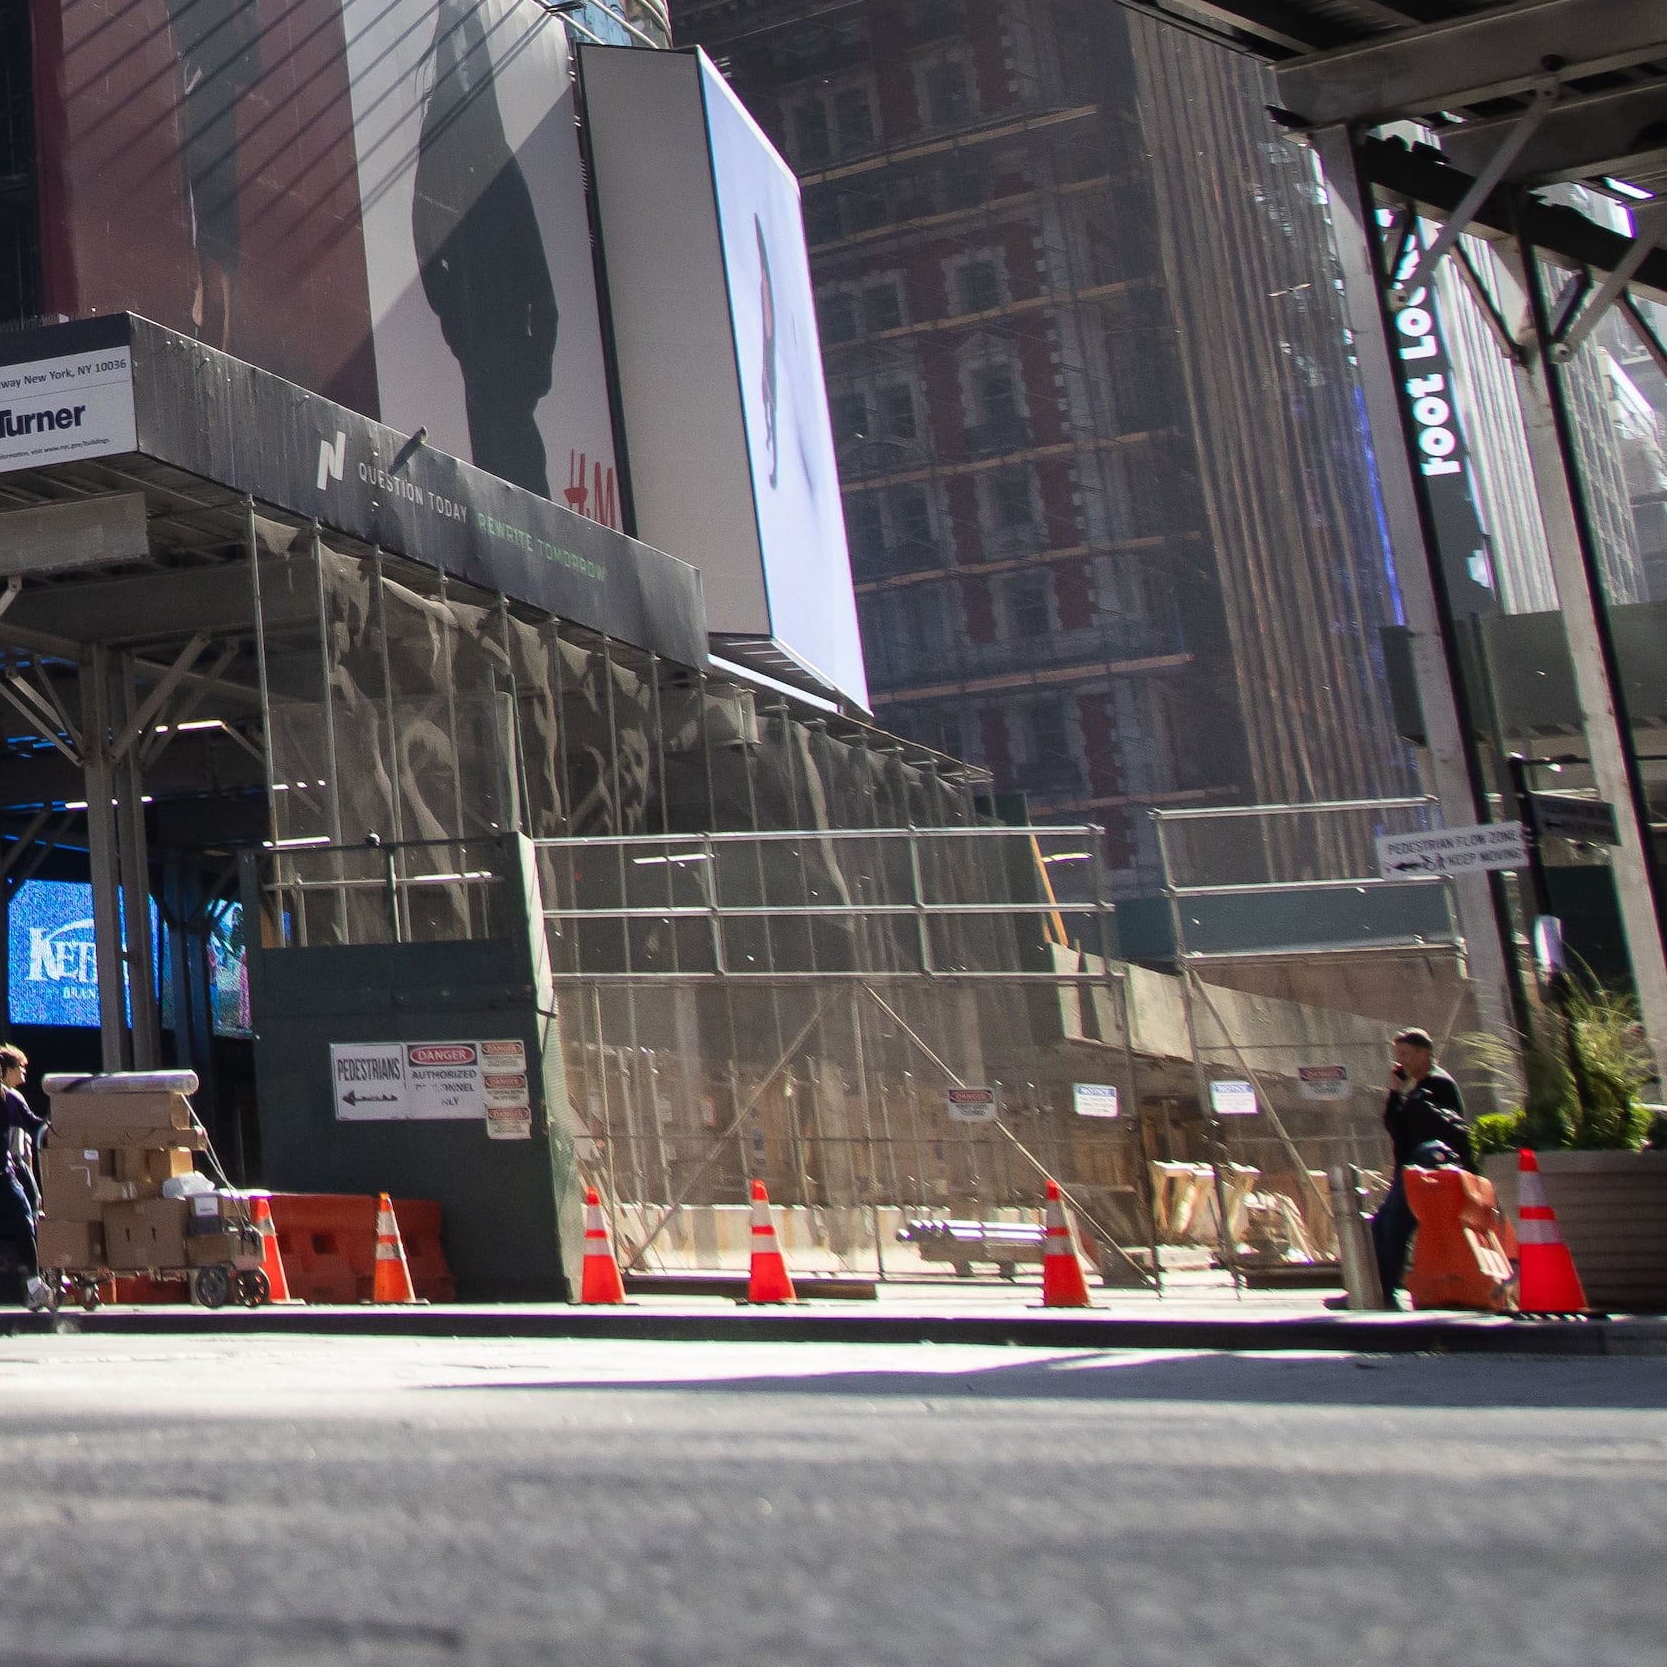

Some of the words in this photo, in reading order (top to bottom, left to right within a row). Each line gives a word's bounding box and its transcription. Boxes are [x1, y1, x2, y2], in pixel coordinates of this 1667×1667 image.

[23, 374, 47, 386] New
[49, 368, 75, 381] York,
[77, 364, 92, 376] NY
[95, 358, 127, 373] 10036
[358, 462, 424, 506] QUESTION
[426, 491, 467, 524] TODAY
[476, 512, 534, 553] REWRITE
[417, 1049, 469, 1062] DANGER
[337, 1057, 402, 1082] PEDESTRIANS
[411, 1070, 477, 1080] AUTHORIZED
